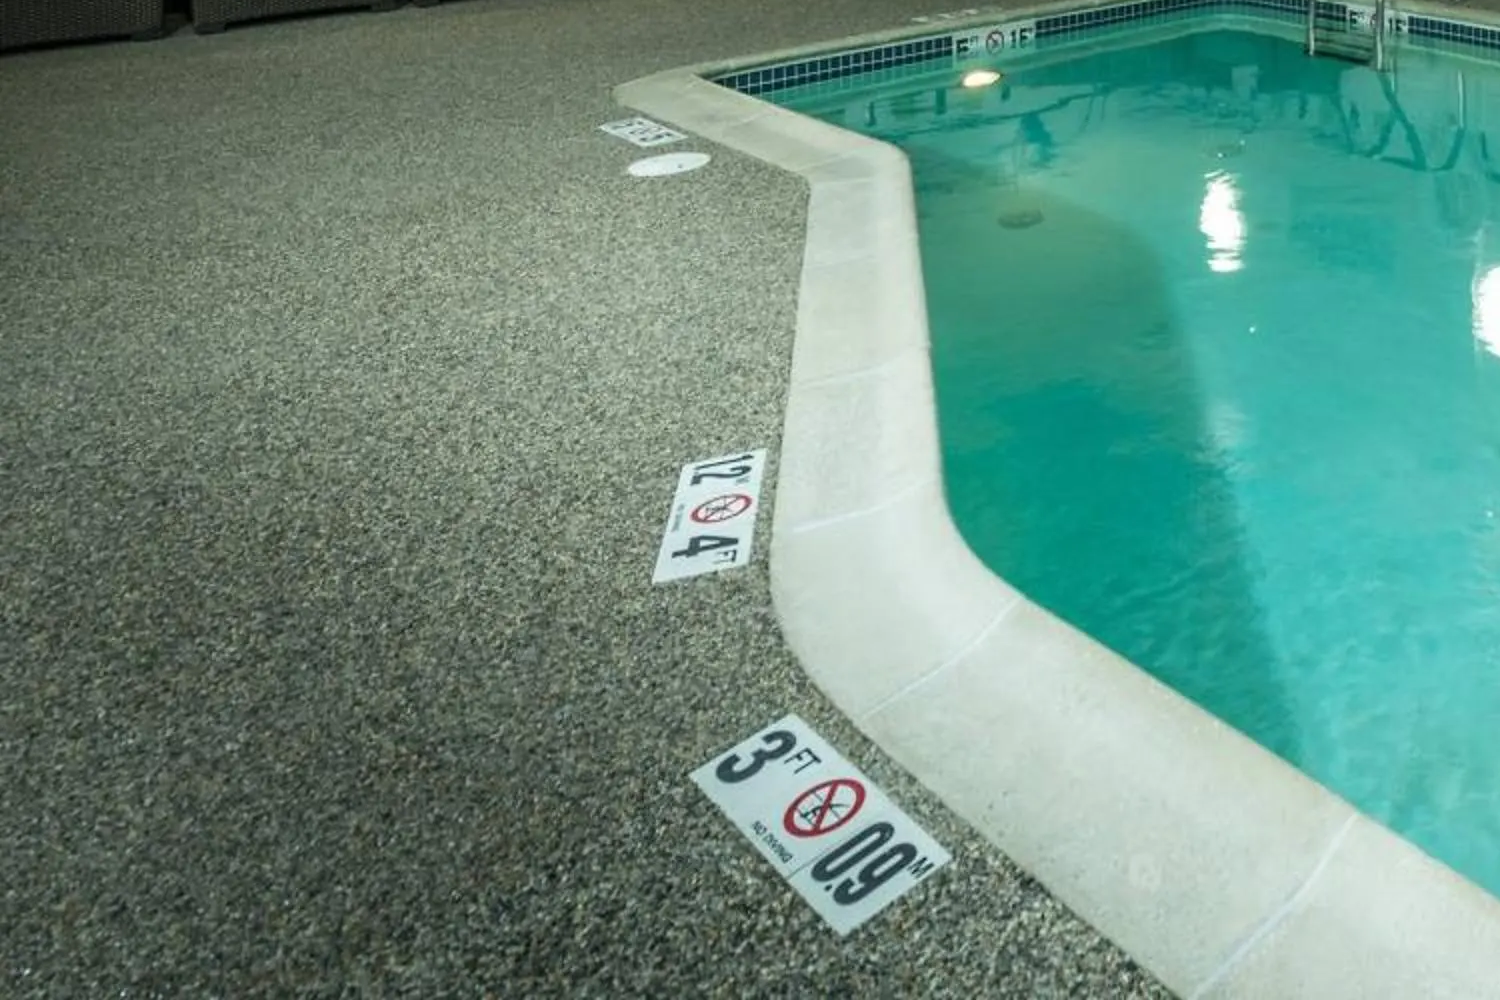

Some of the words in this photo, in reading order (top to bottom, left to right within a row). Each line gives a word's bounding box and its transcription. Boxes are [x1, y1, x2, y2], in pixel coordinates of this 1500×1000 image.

[671, 535, 739, 559] 4
[715, 730, 797, 784] 3
[783, 747, 822, 774] FT
